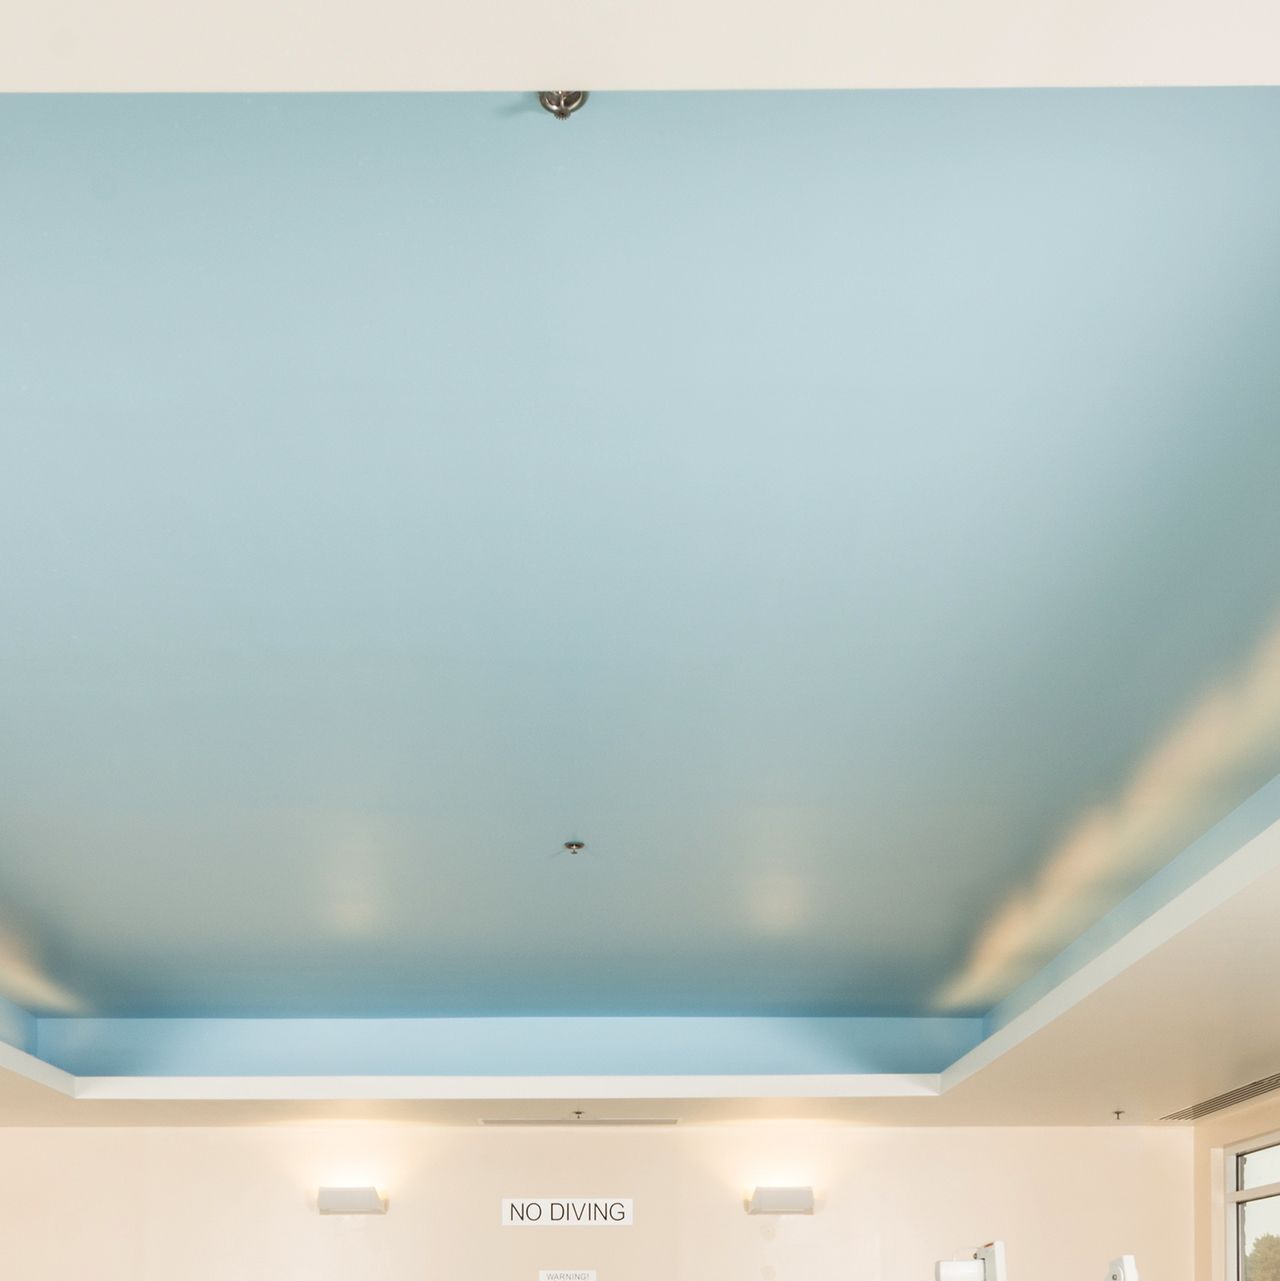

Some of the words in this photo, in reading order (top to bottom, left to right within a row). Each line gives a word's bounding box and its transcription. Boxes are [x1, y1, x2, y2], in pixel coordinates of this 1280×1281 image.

[510, 1202, 543, 1222] NO
[550, 1202, 626, 1222] DIVING
[545, 1272, 590, 1281] WARNING!
